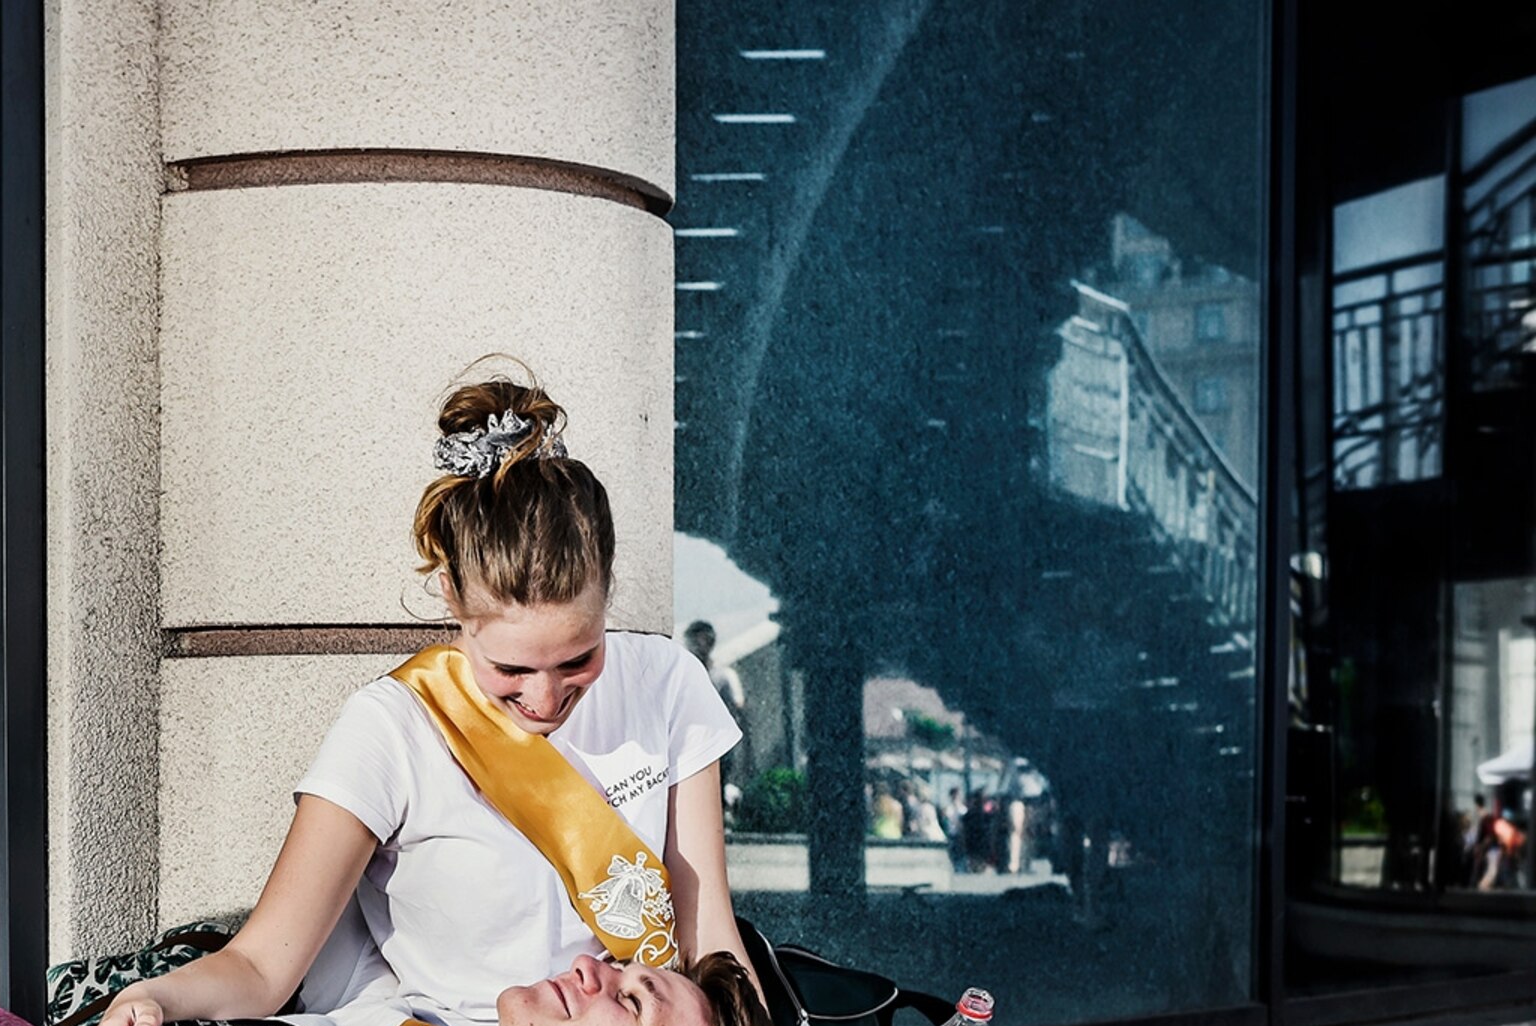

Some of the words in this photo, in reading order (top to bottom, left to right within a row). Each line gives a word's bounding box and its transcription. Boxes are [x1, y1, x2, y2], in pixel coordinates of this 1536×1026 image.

[605, 779, 629, 797] CAN
[629, 765, 652, 784] YOU
[607, 794, 628, 808] CH
[629, 784, 644, 800] MY
